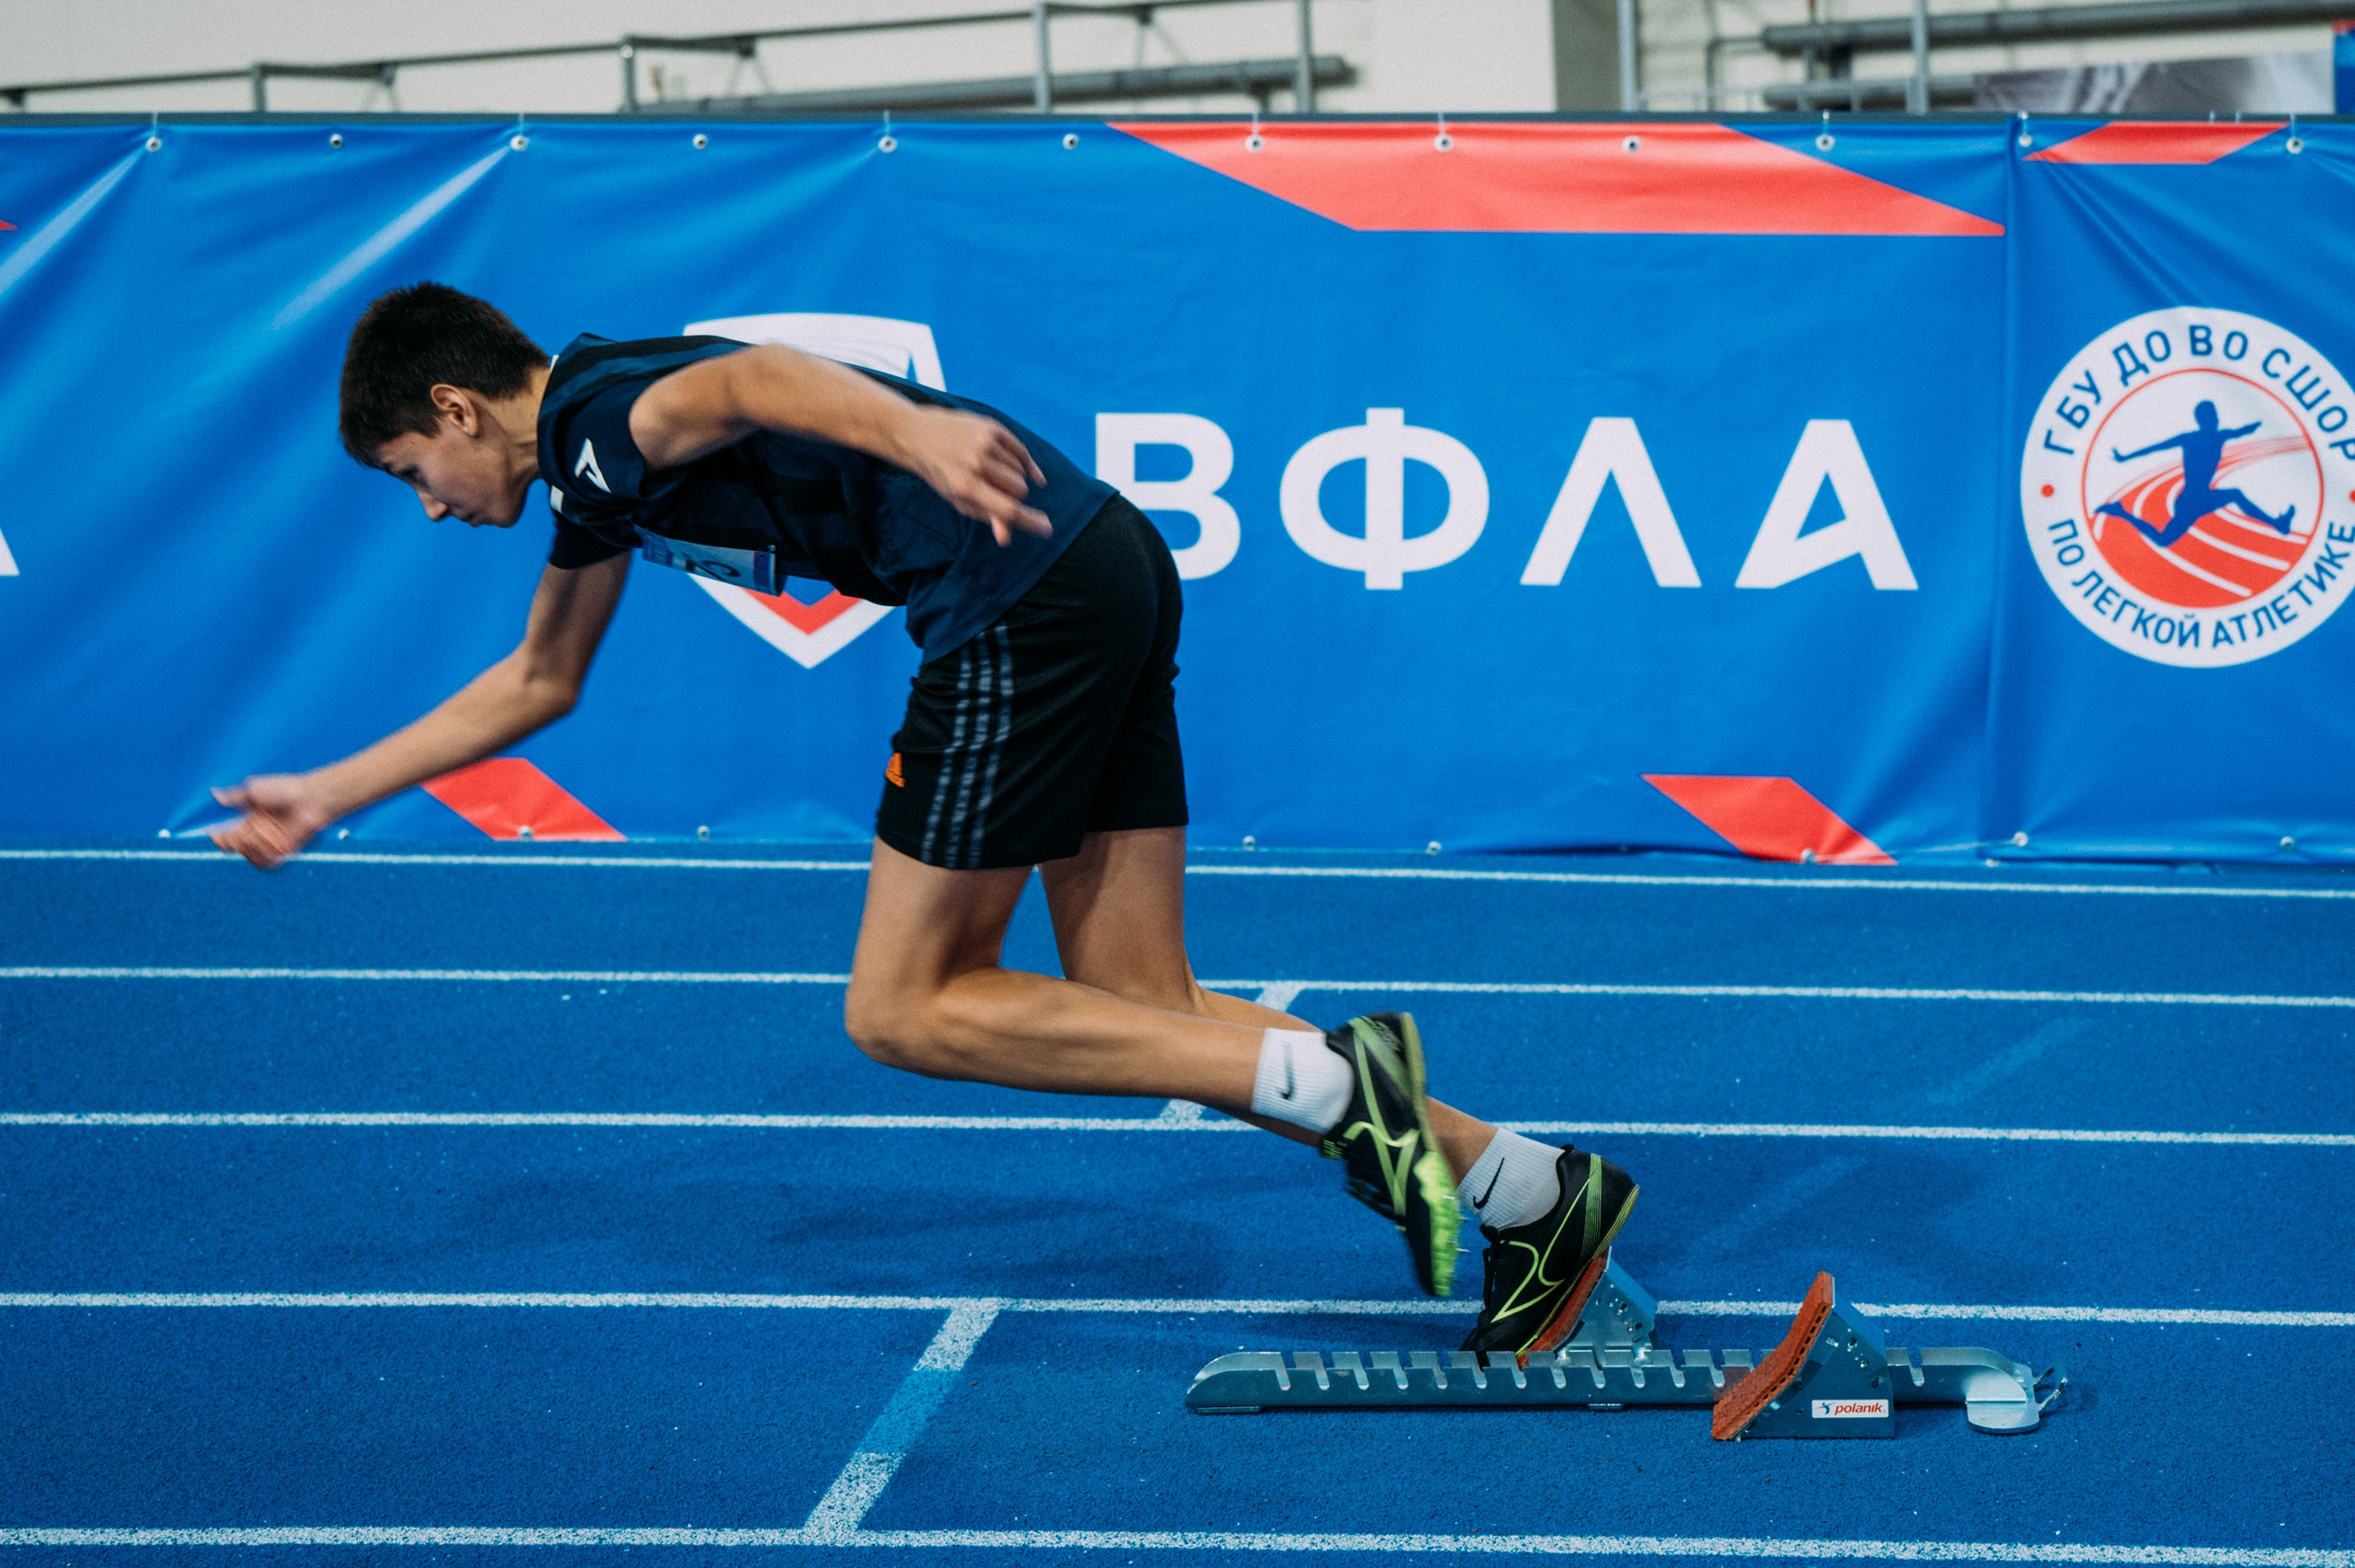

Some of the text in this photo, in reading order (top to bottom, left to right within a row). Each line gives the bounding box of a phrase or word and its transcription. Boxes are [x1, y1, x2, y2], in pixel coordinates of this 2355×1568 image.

[2043, 325, 2355, 461] ГБУ ДО ВО СШОР
[1095, 406, 1919, 590] ВФЛА
[2048, 519, 2355, 647] ПО ЛЕГКОЙ АТЛЕТИКЕ
[1834, 1402, 1883, 1415] polanik
